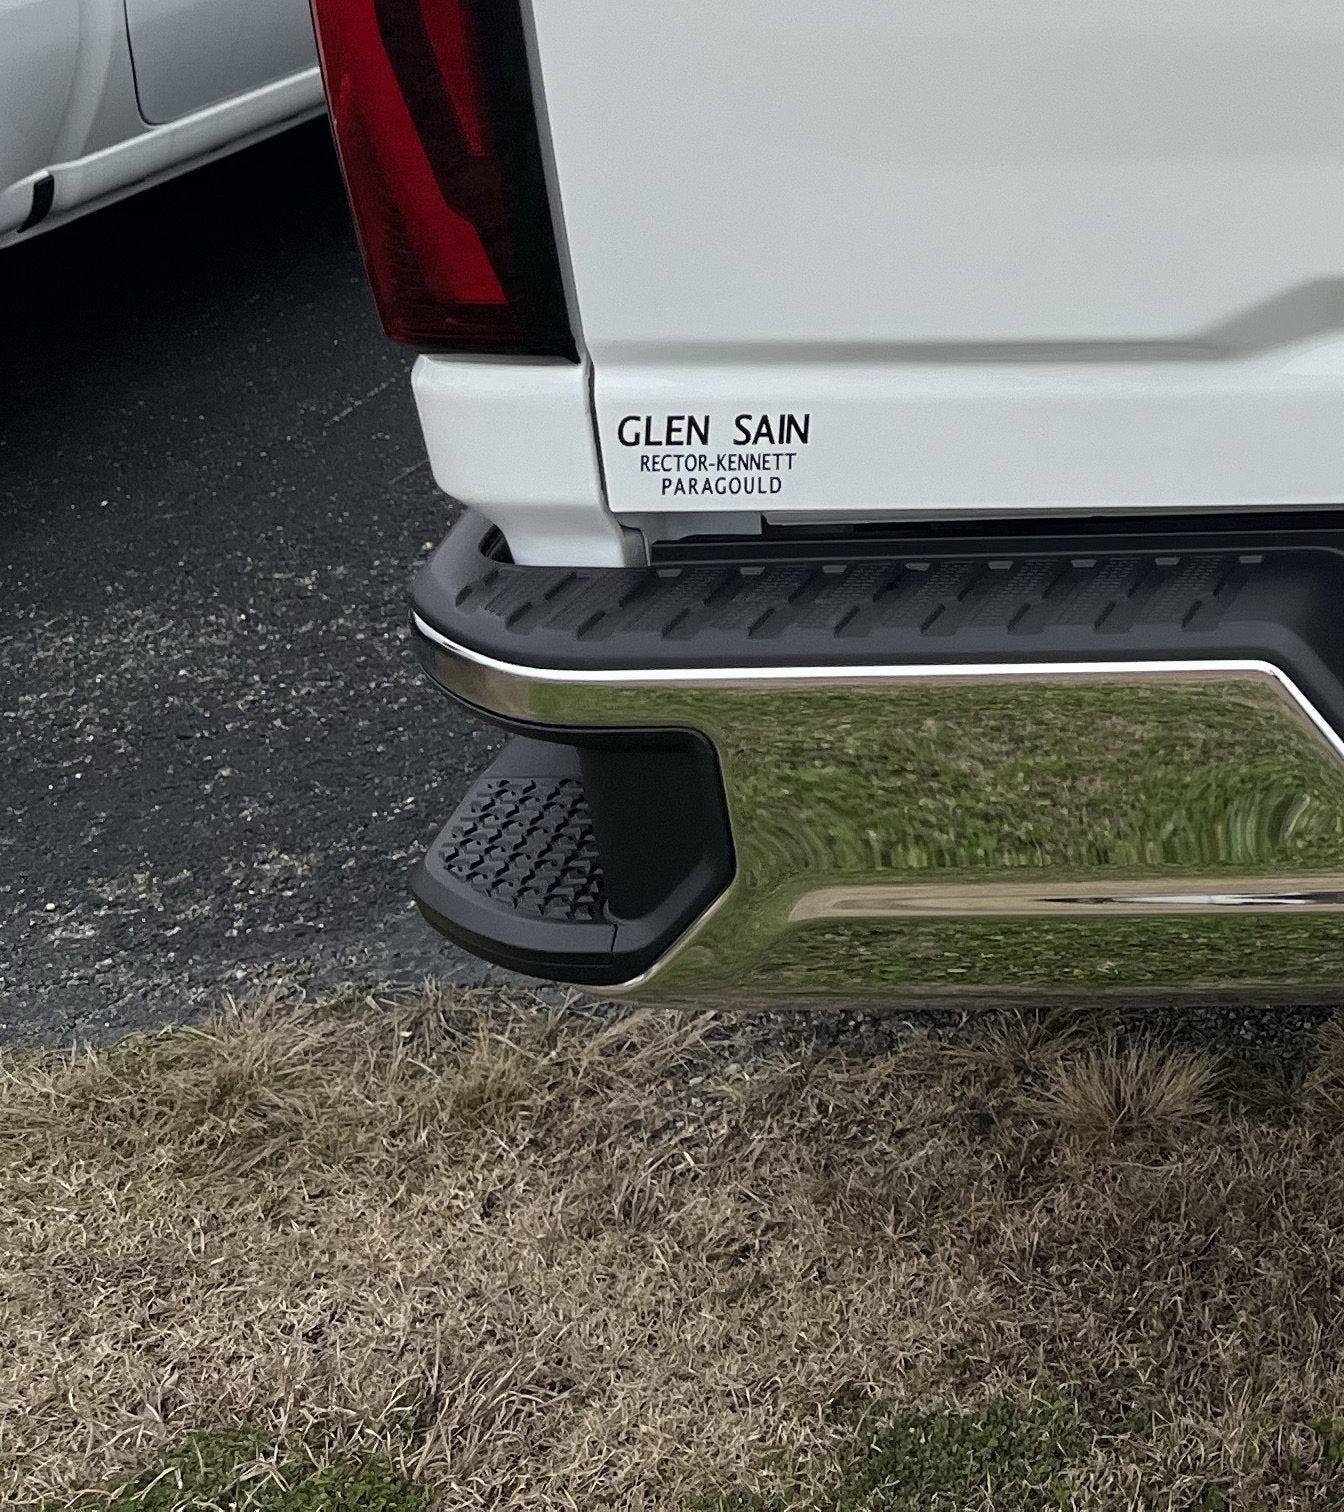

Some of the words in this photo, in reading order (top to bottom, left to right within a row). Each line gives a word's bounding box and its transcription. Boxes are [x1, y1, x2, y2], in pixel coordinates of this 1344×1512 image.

[617, 415, 711, 447] GLEN
[732, 413, 810, 445] SAIN
[640, 452, 798, 472] RECTOR-KENNETT
[661, 476, 782, 496] PARAGOULD
